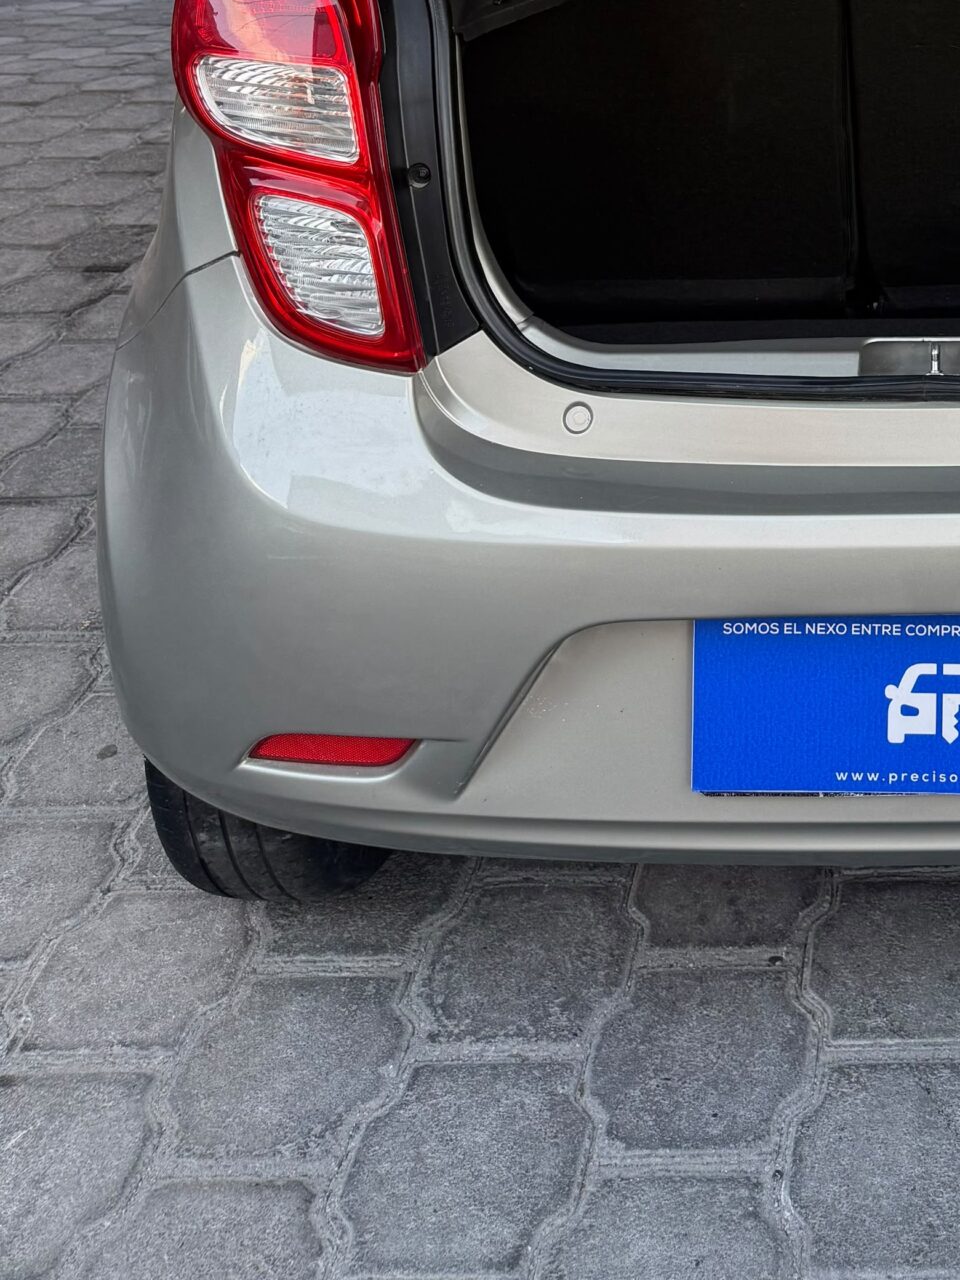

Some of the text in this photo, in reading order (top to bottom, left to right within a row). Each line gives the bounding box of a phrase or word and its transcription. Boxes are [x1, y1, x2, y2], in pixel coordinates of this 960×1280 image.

[722, 623, 780, 636] SOMOS
[783, 624, 802, 636] EL
[805, 623, 847, 636] NEXO
[851, 624, 902, 637] ENTRE
